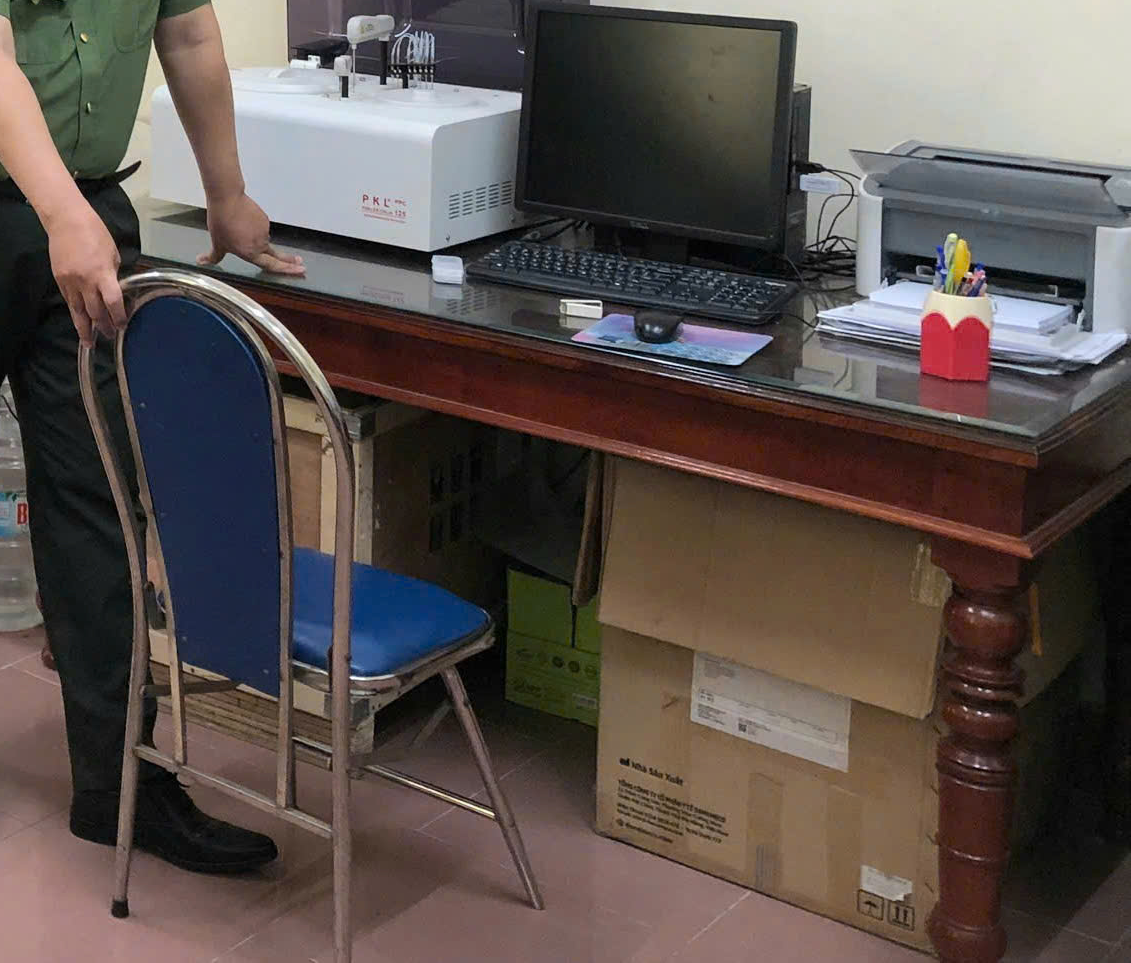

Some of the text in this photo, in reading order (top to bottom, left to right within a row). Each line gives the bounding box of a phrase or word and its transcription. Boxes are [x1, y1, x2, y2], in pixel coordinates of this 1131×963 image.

[631, 760, 684, 787] Nhà Sản Xuất
